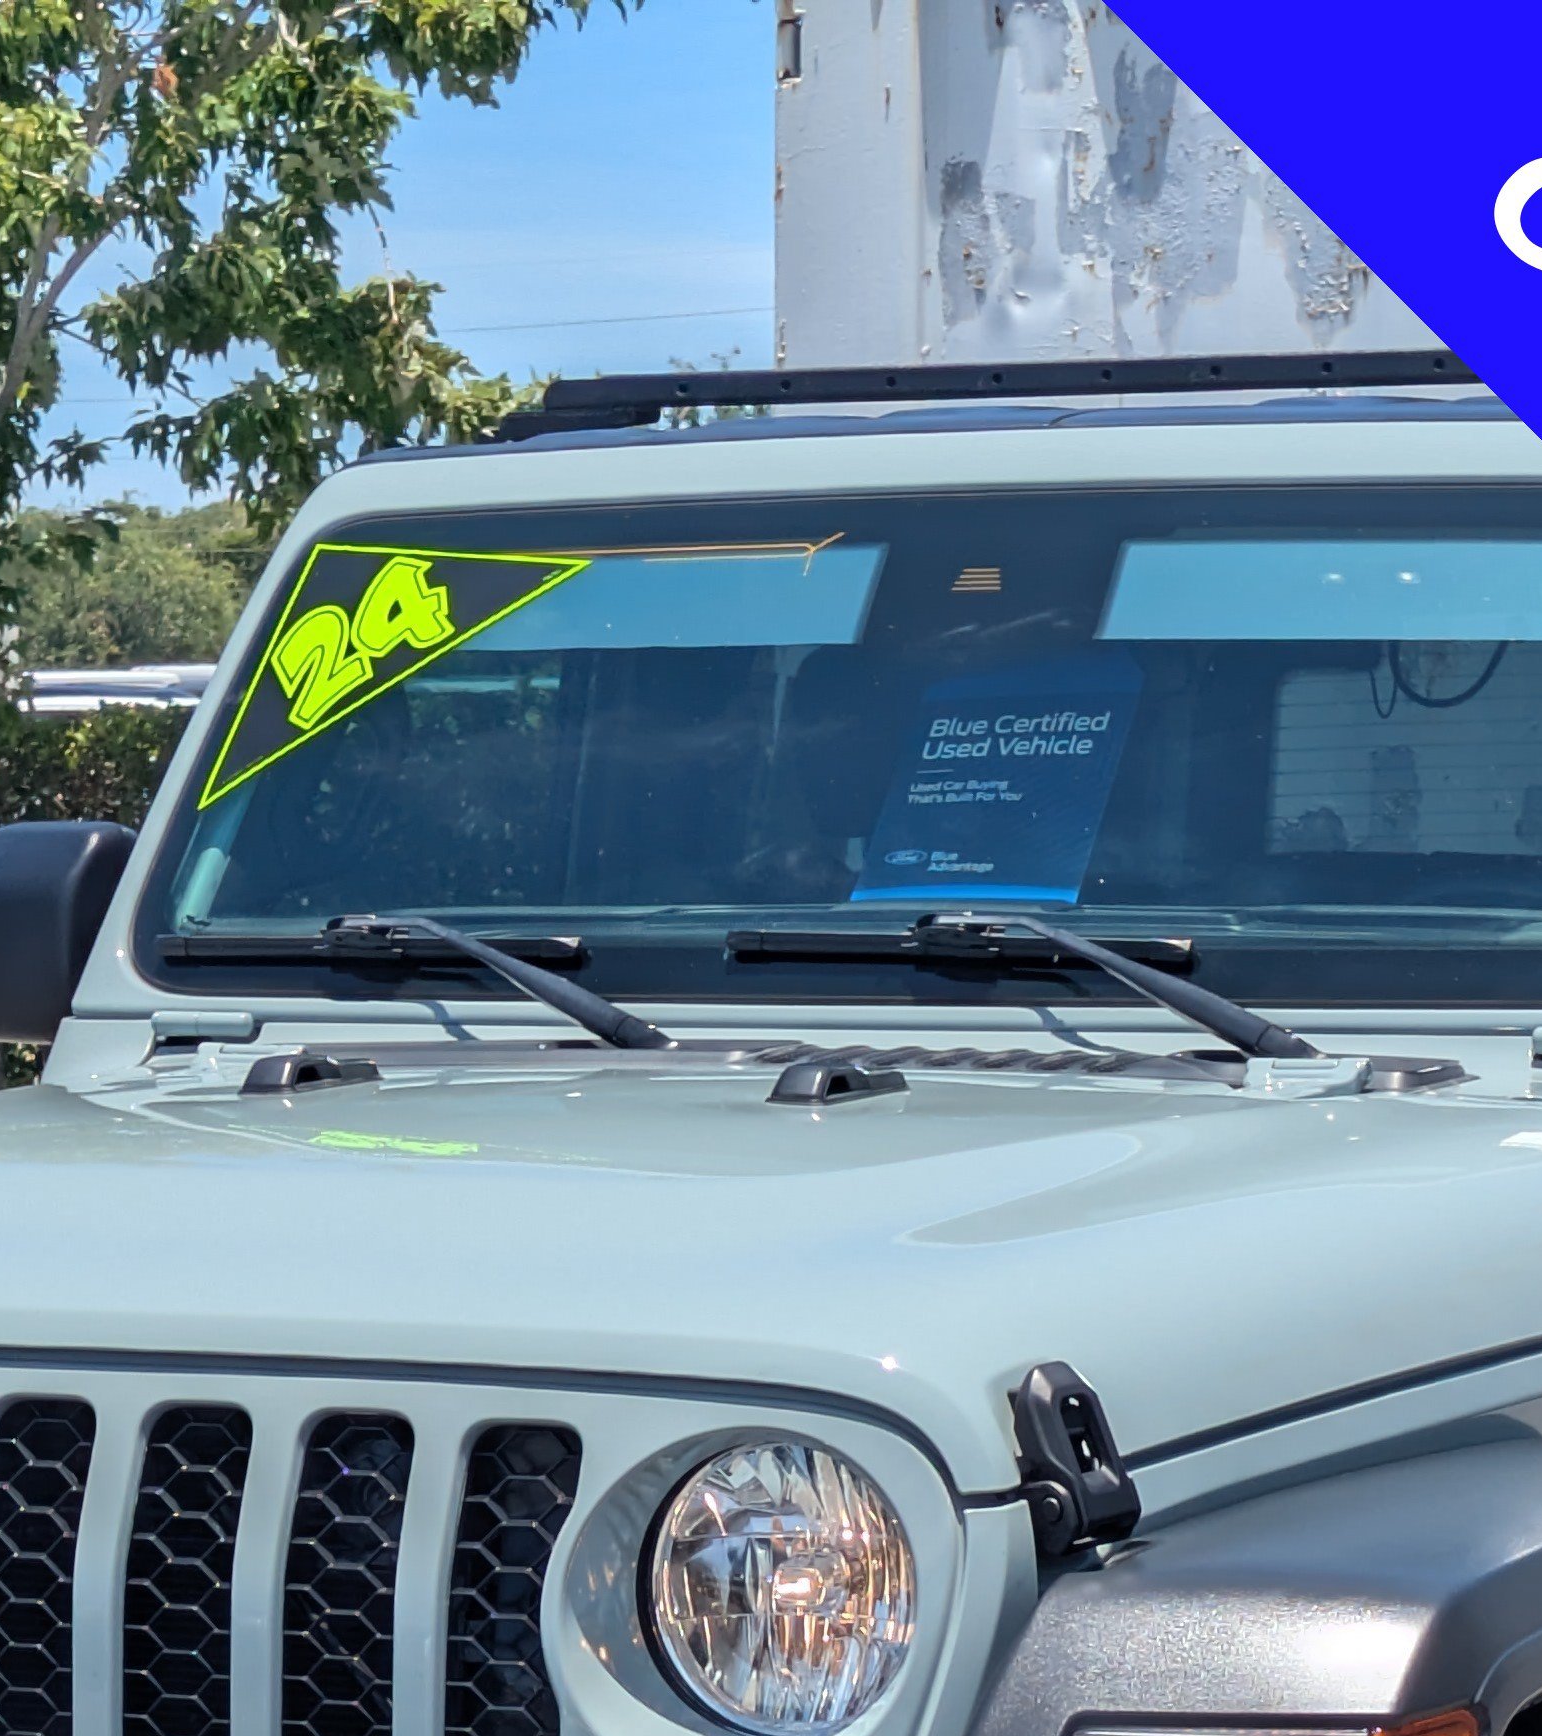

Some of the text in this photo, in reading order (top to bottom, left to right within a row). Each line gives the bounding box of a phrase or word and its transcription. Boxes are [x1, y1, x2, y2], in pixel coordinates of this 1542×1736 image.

[270, 555, 456, 730] 24
[929, 711, 1111, 738] Blue Certified
[922, 735, 1093, 760] Used Vehicle
